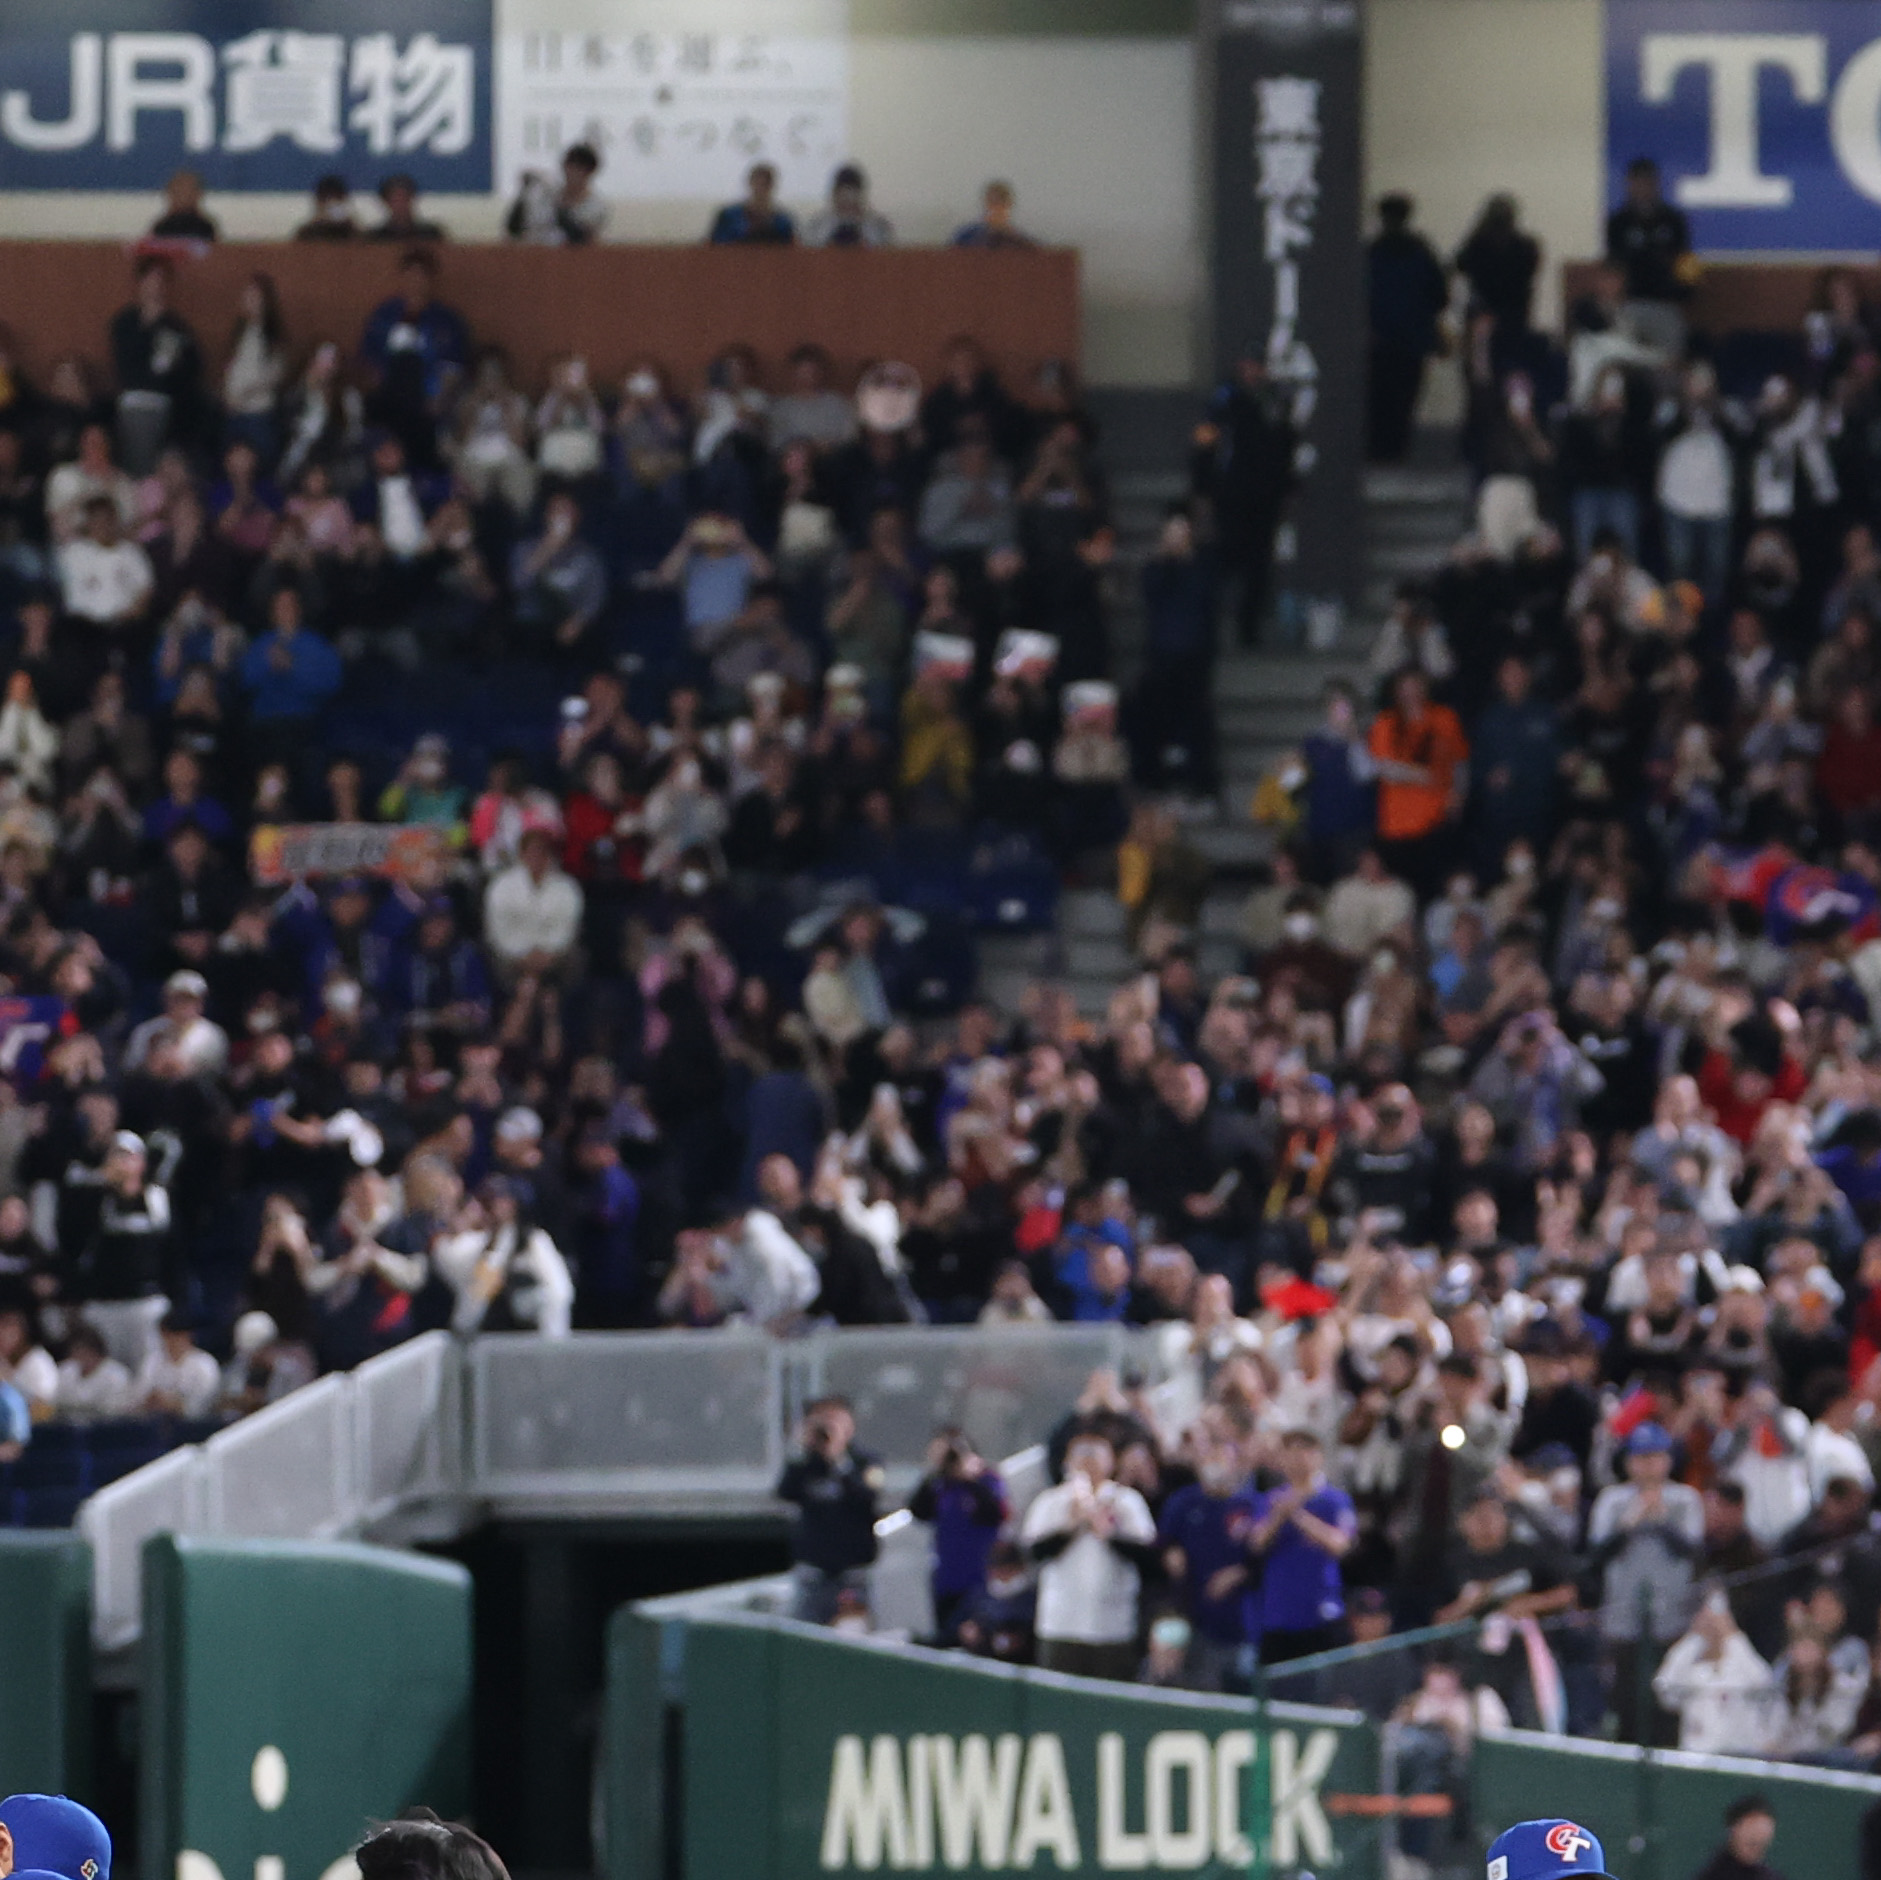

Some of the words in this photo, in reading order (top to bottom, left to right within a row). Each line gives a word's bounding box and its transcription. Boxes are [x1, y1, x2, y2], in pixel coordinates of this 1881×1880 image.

[0, 27, 475, 155] JR貨物
[821, 1733, 1081, 1871] MIWA
[1097, 1729, 1344, 1870] LOCK
